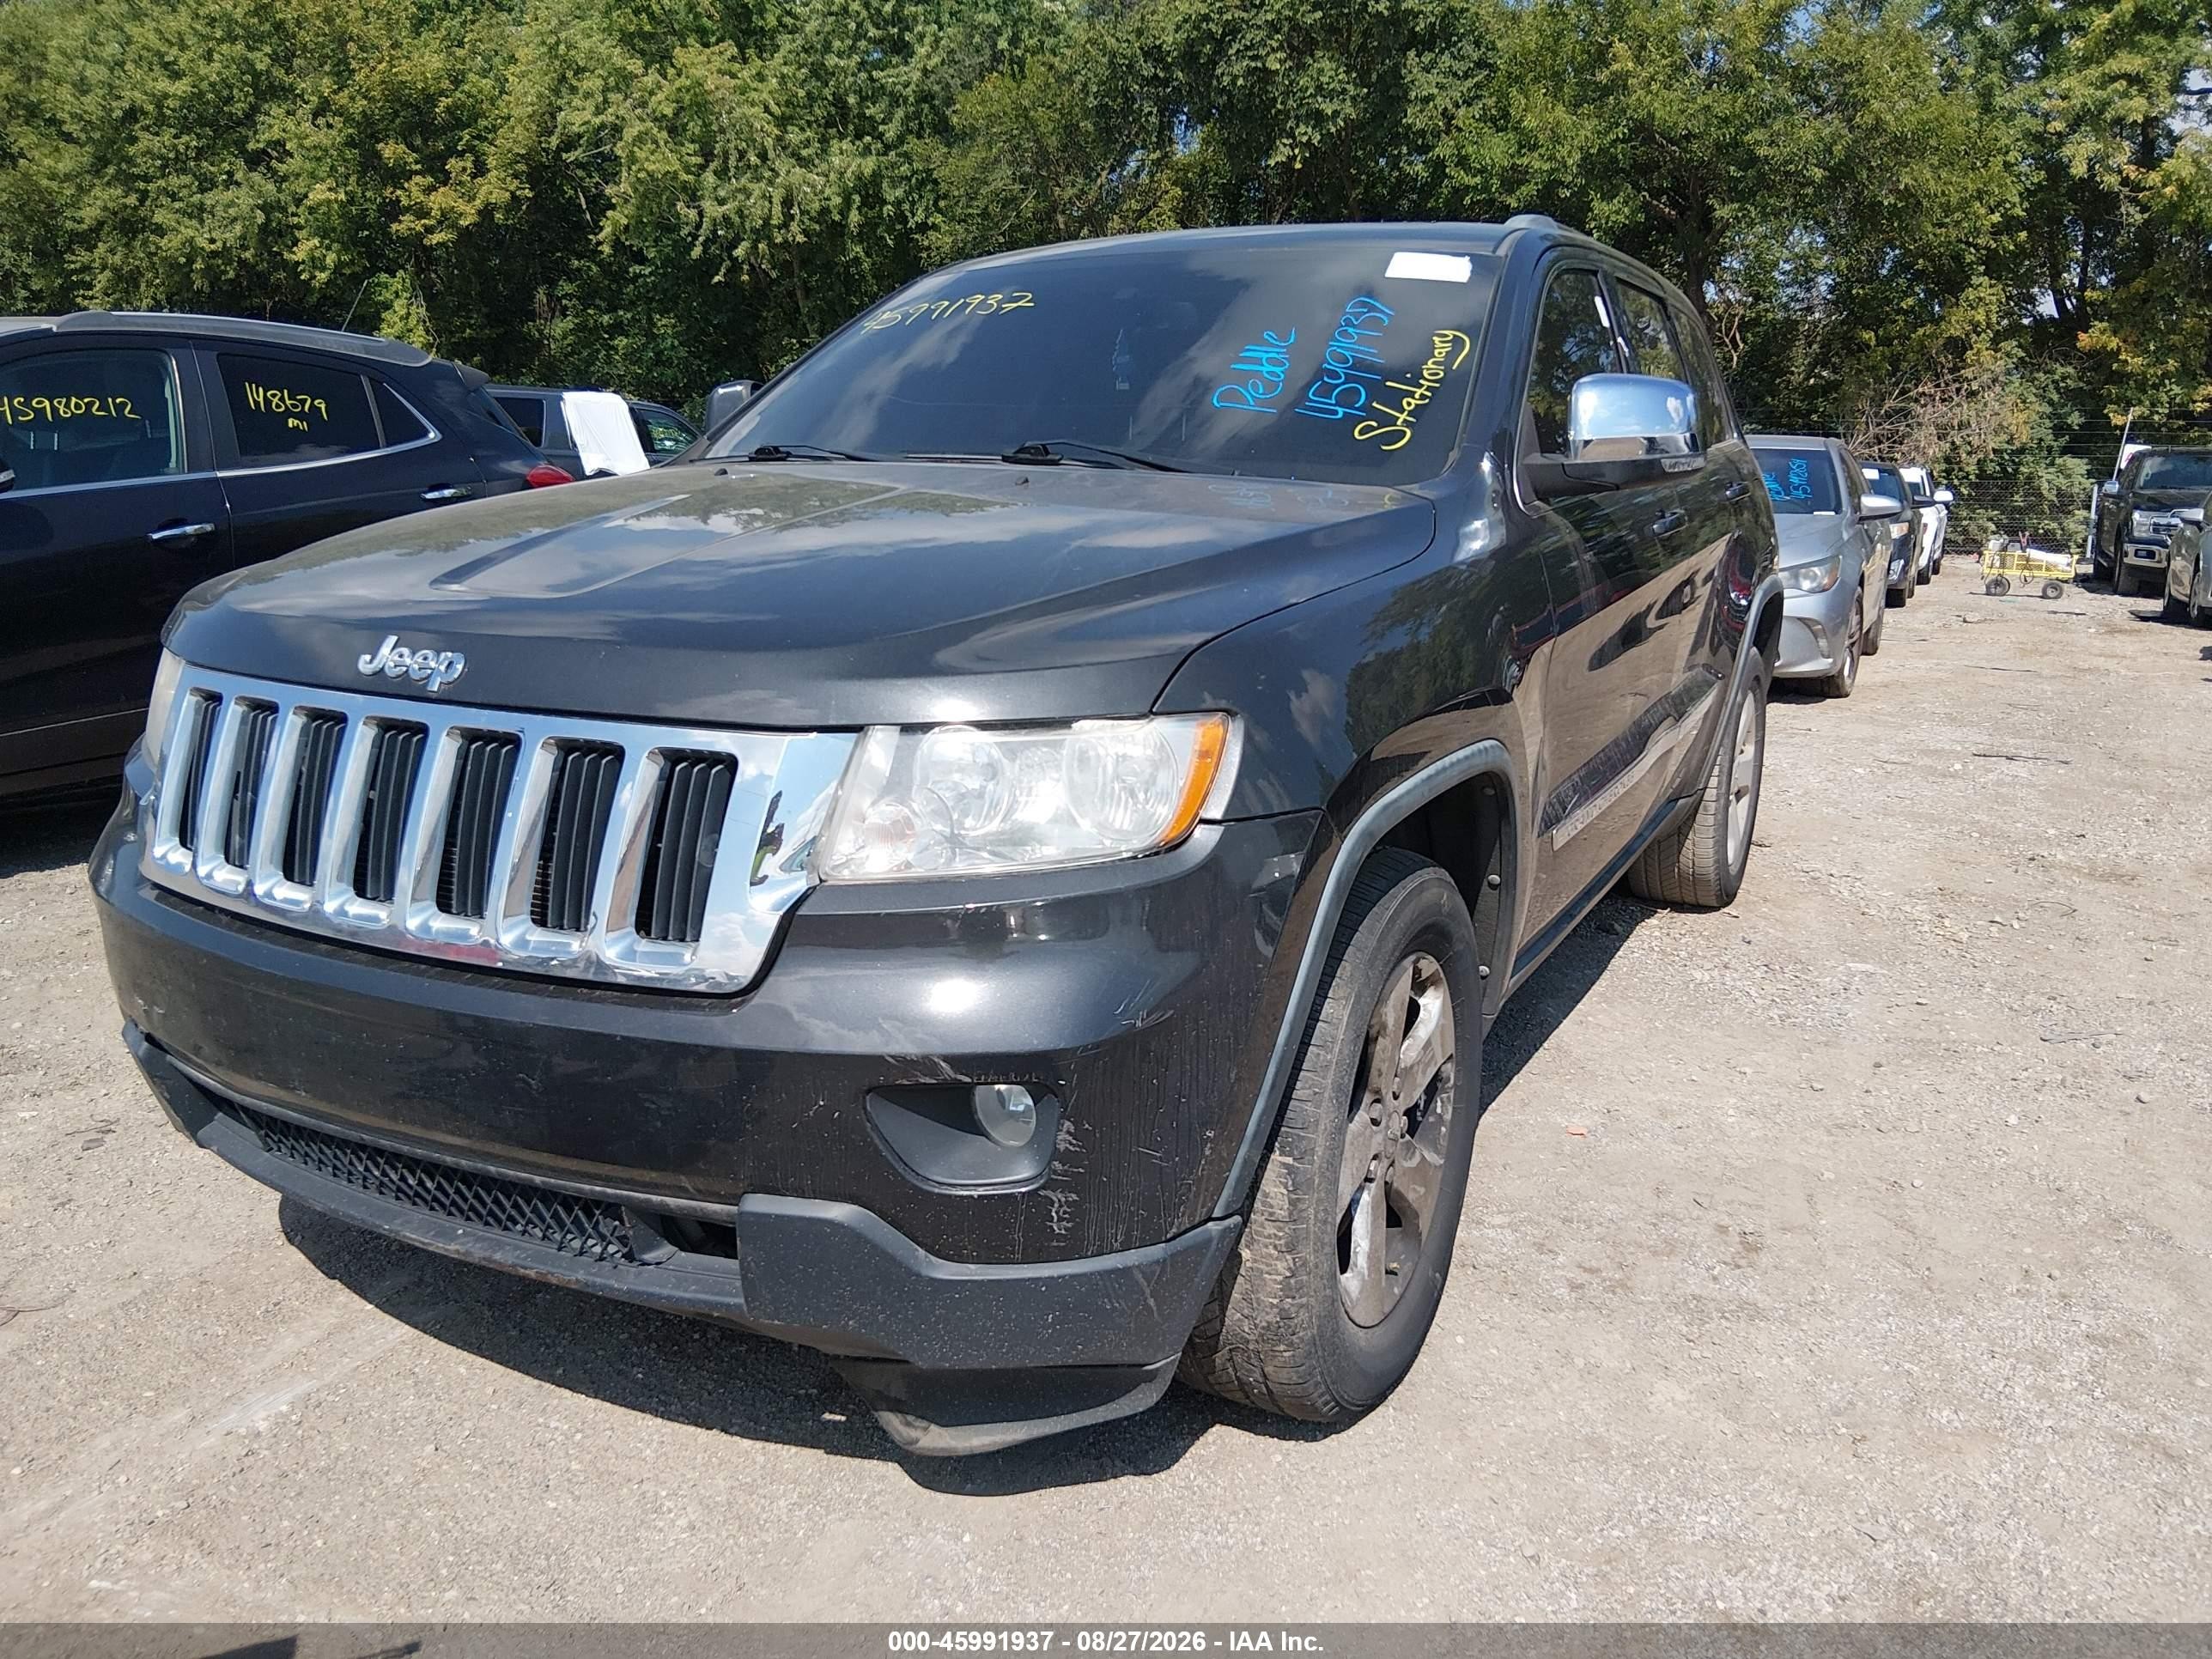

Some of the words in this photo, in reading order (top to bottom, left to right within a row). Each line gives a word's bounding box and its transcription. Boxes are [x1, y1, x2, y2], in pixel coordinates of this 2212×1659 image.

[1212, 327, 1296, 413] Peddle
[1294, 295, 1395, 419] 45991937
[1353, 330, 1470, 451] Stationary
[0, 396, 142, 425] 45980212
[245, 381, 328, 421] 148679
[357, 635, 465, 692] Jeep
